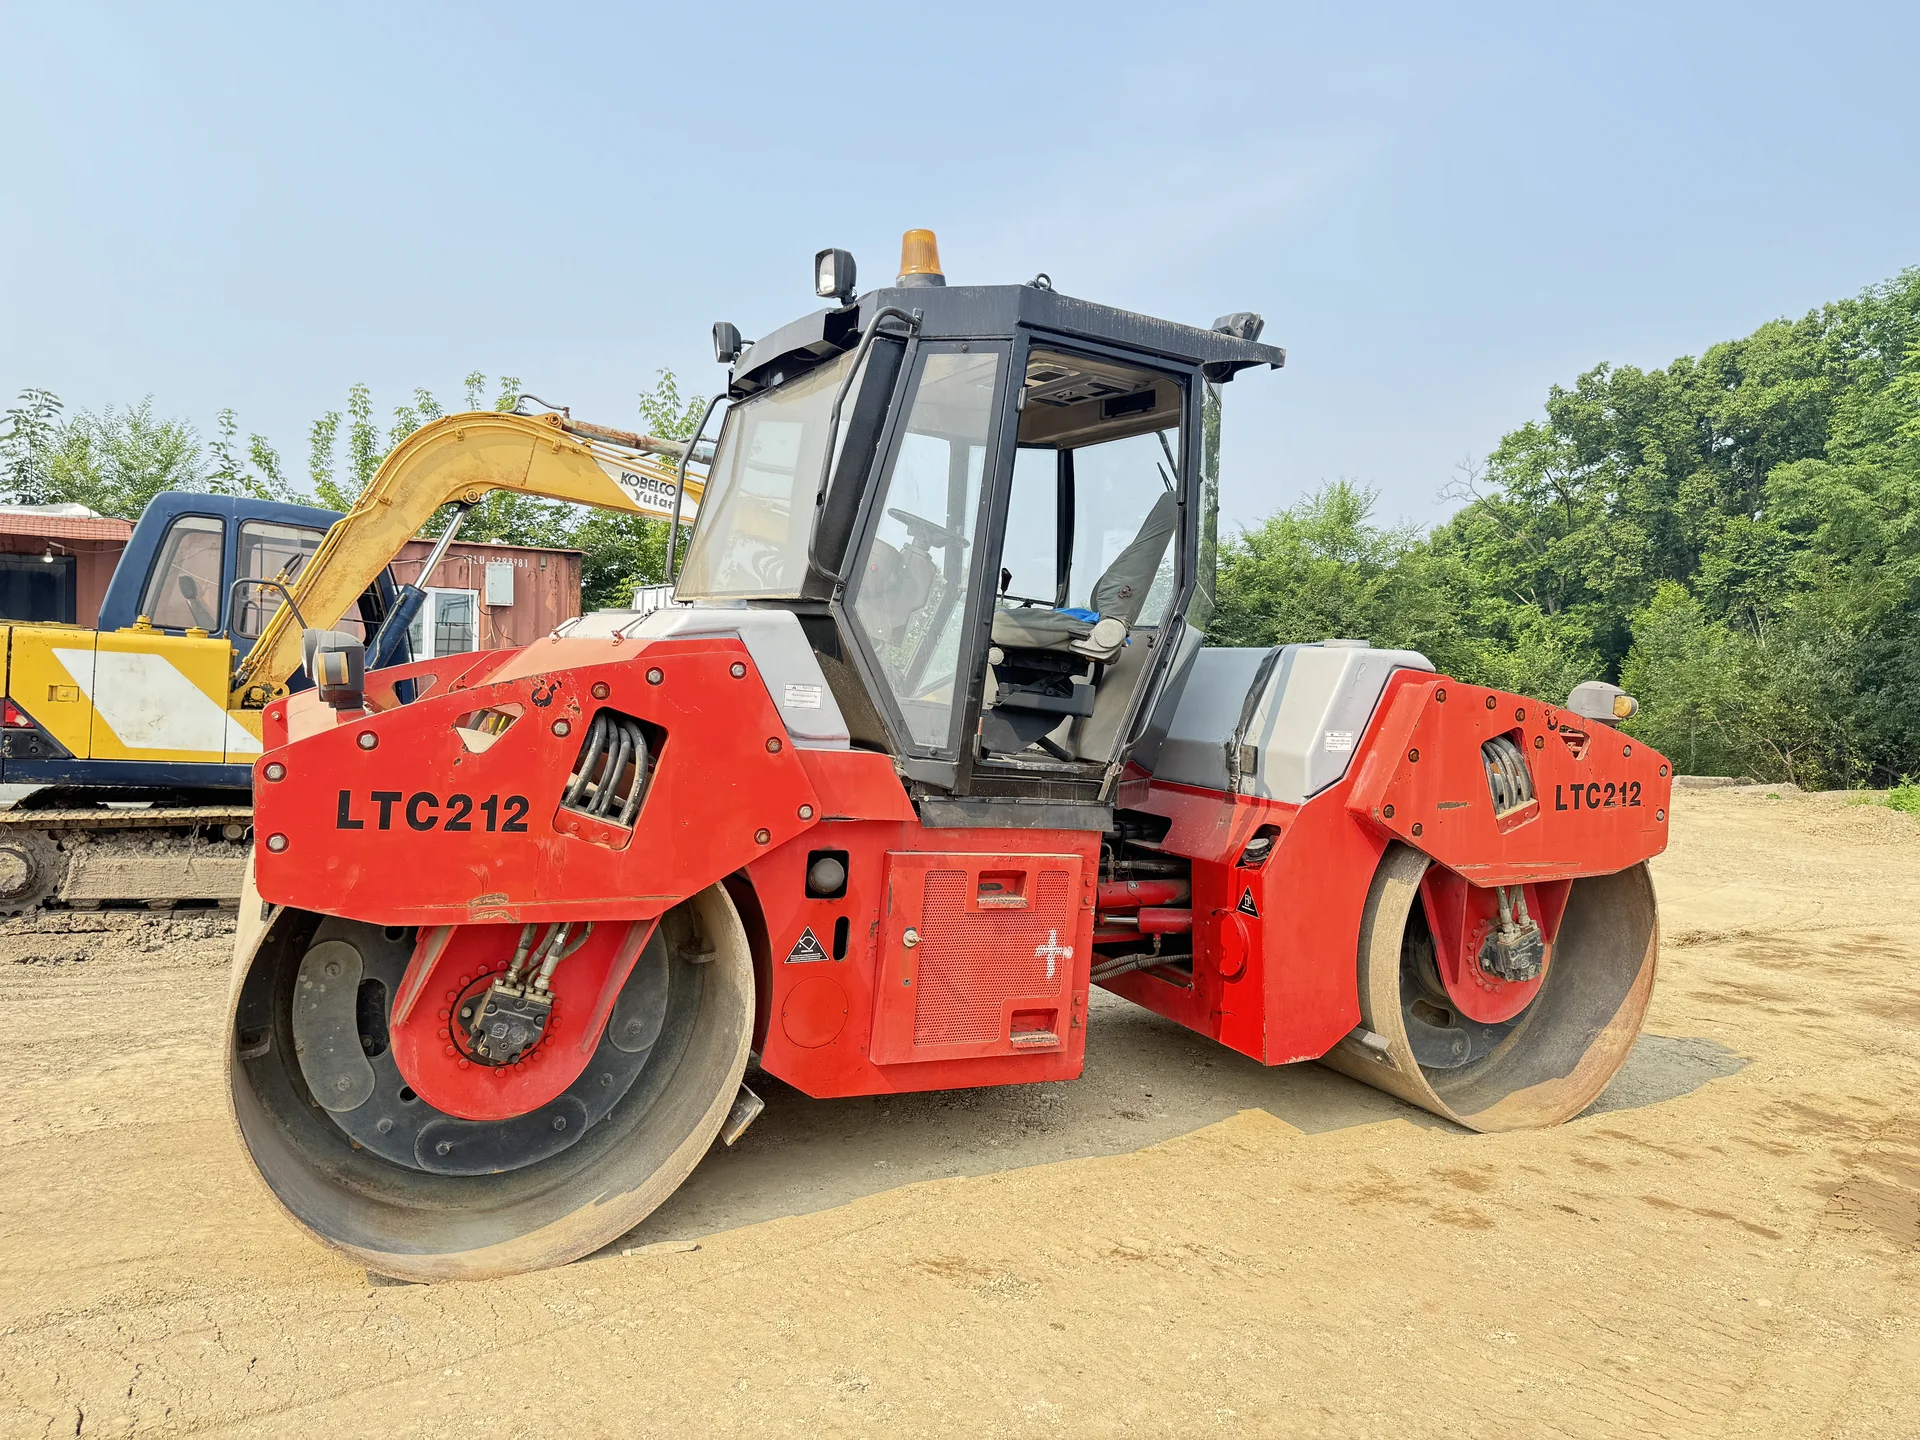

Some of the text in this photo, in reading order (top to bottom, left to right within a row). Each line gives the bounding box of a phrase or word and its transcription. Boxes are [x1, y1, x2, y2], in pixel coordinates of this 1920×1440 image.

[620, 471, 676, 497] KOBELCO
[336, 789, 530, 832] LTC212
[1555, 781, 1642, 811] LTC212
